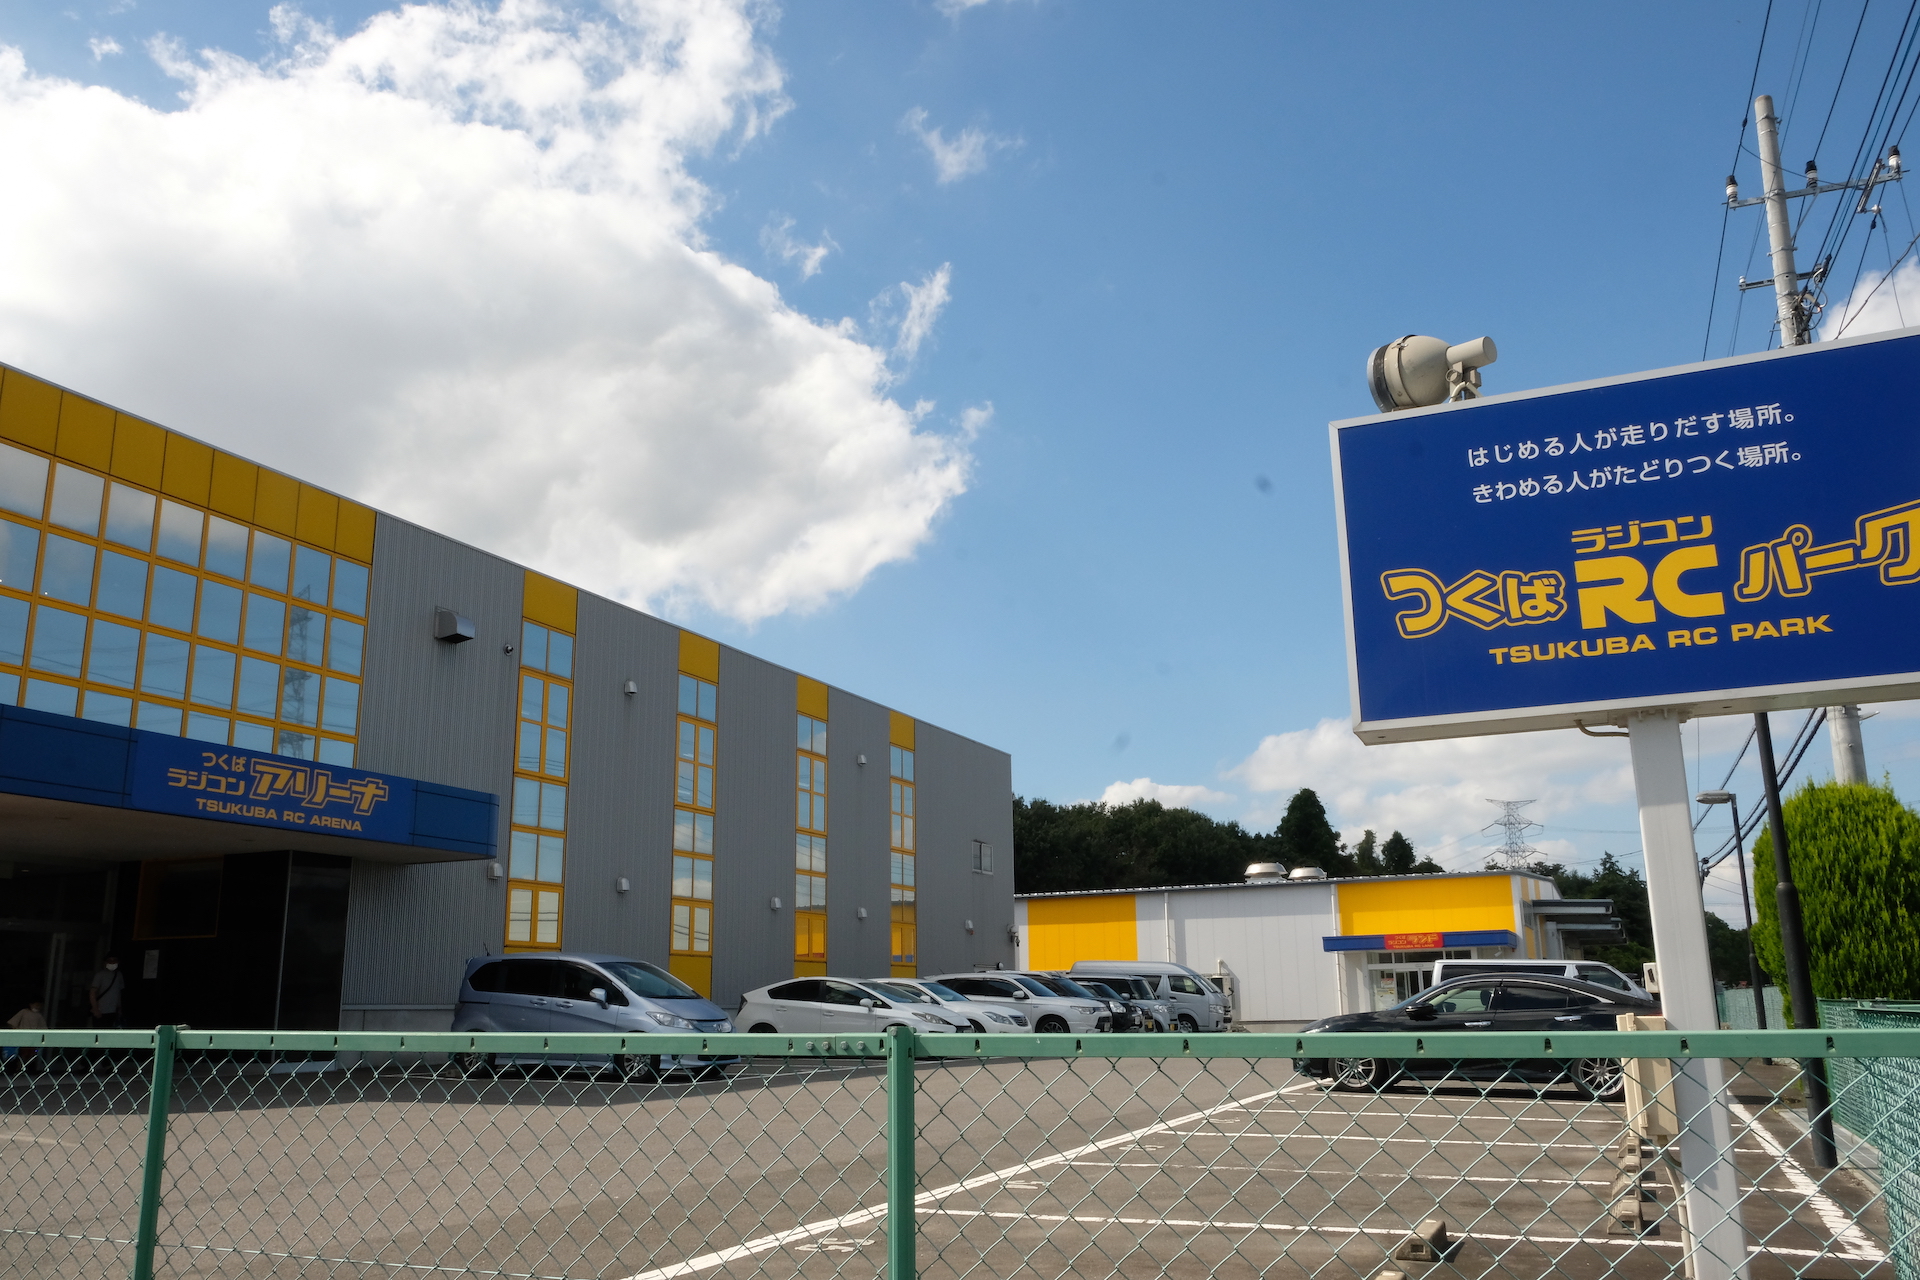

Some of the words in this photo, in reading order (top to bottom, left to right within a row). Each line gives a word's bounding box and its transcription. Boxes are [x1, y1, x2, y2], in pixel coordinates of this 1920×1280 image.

[1467, 403, 1795, 467] はじめる人が走りだす場所。
[1473, 441, 1802, 503] きわめる人がたどりつく場所。
[1571, 515, 1712, 553] ラジコン
[1489, 634, 1656, 665] TSUKUBA
[1667, 626, 1719, 649] RC
[1731, 614, 1834, 642] PARK
[167, 768, 245, 796] ラジコン
[202, 752, 246, 772] つくば
[250, 758, 389, 815] アリーナ
[196, 798, 277, 821] TSUKUBA
[283, 810, 305, 824] RC
[310, 815, 362, 832] ARENA
